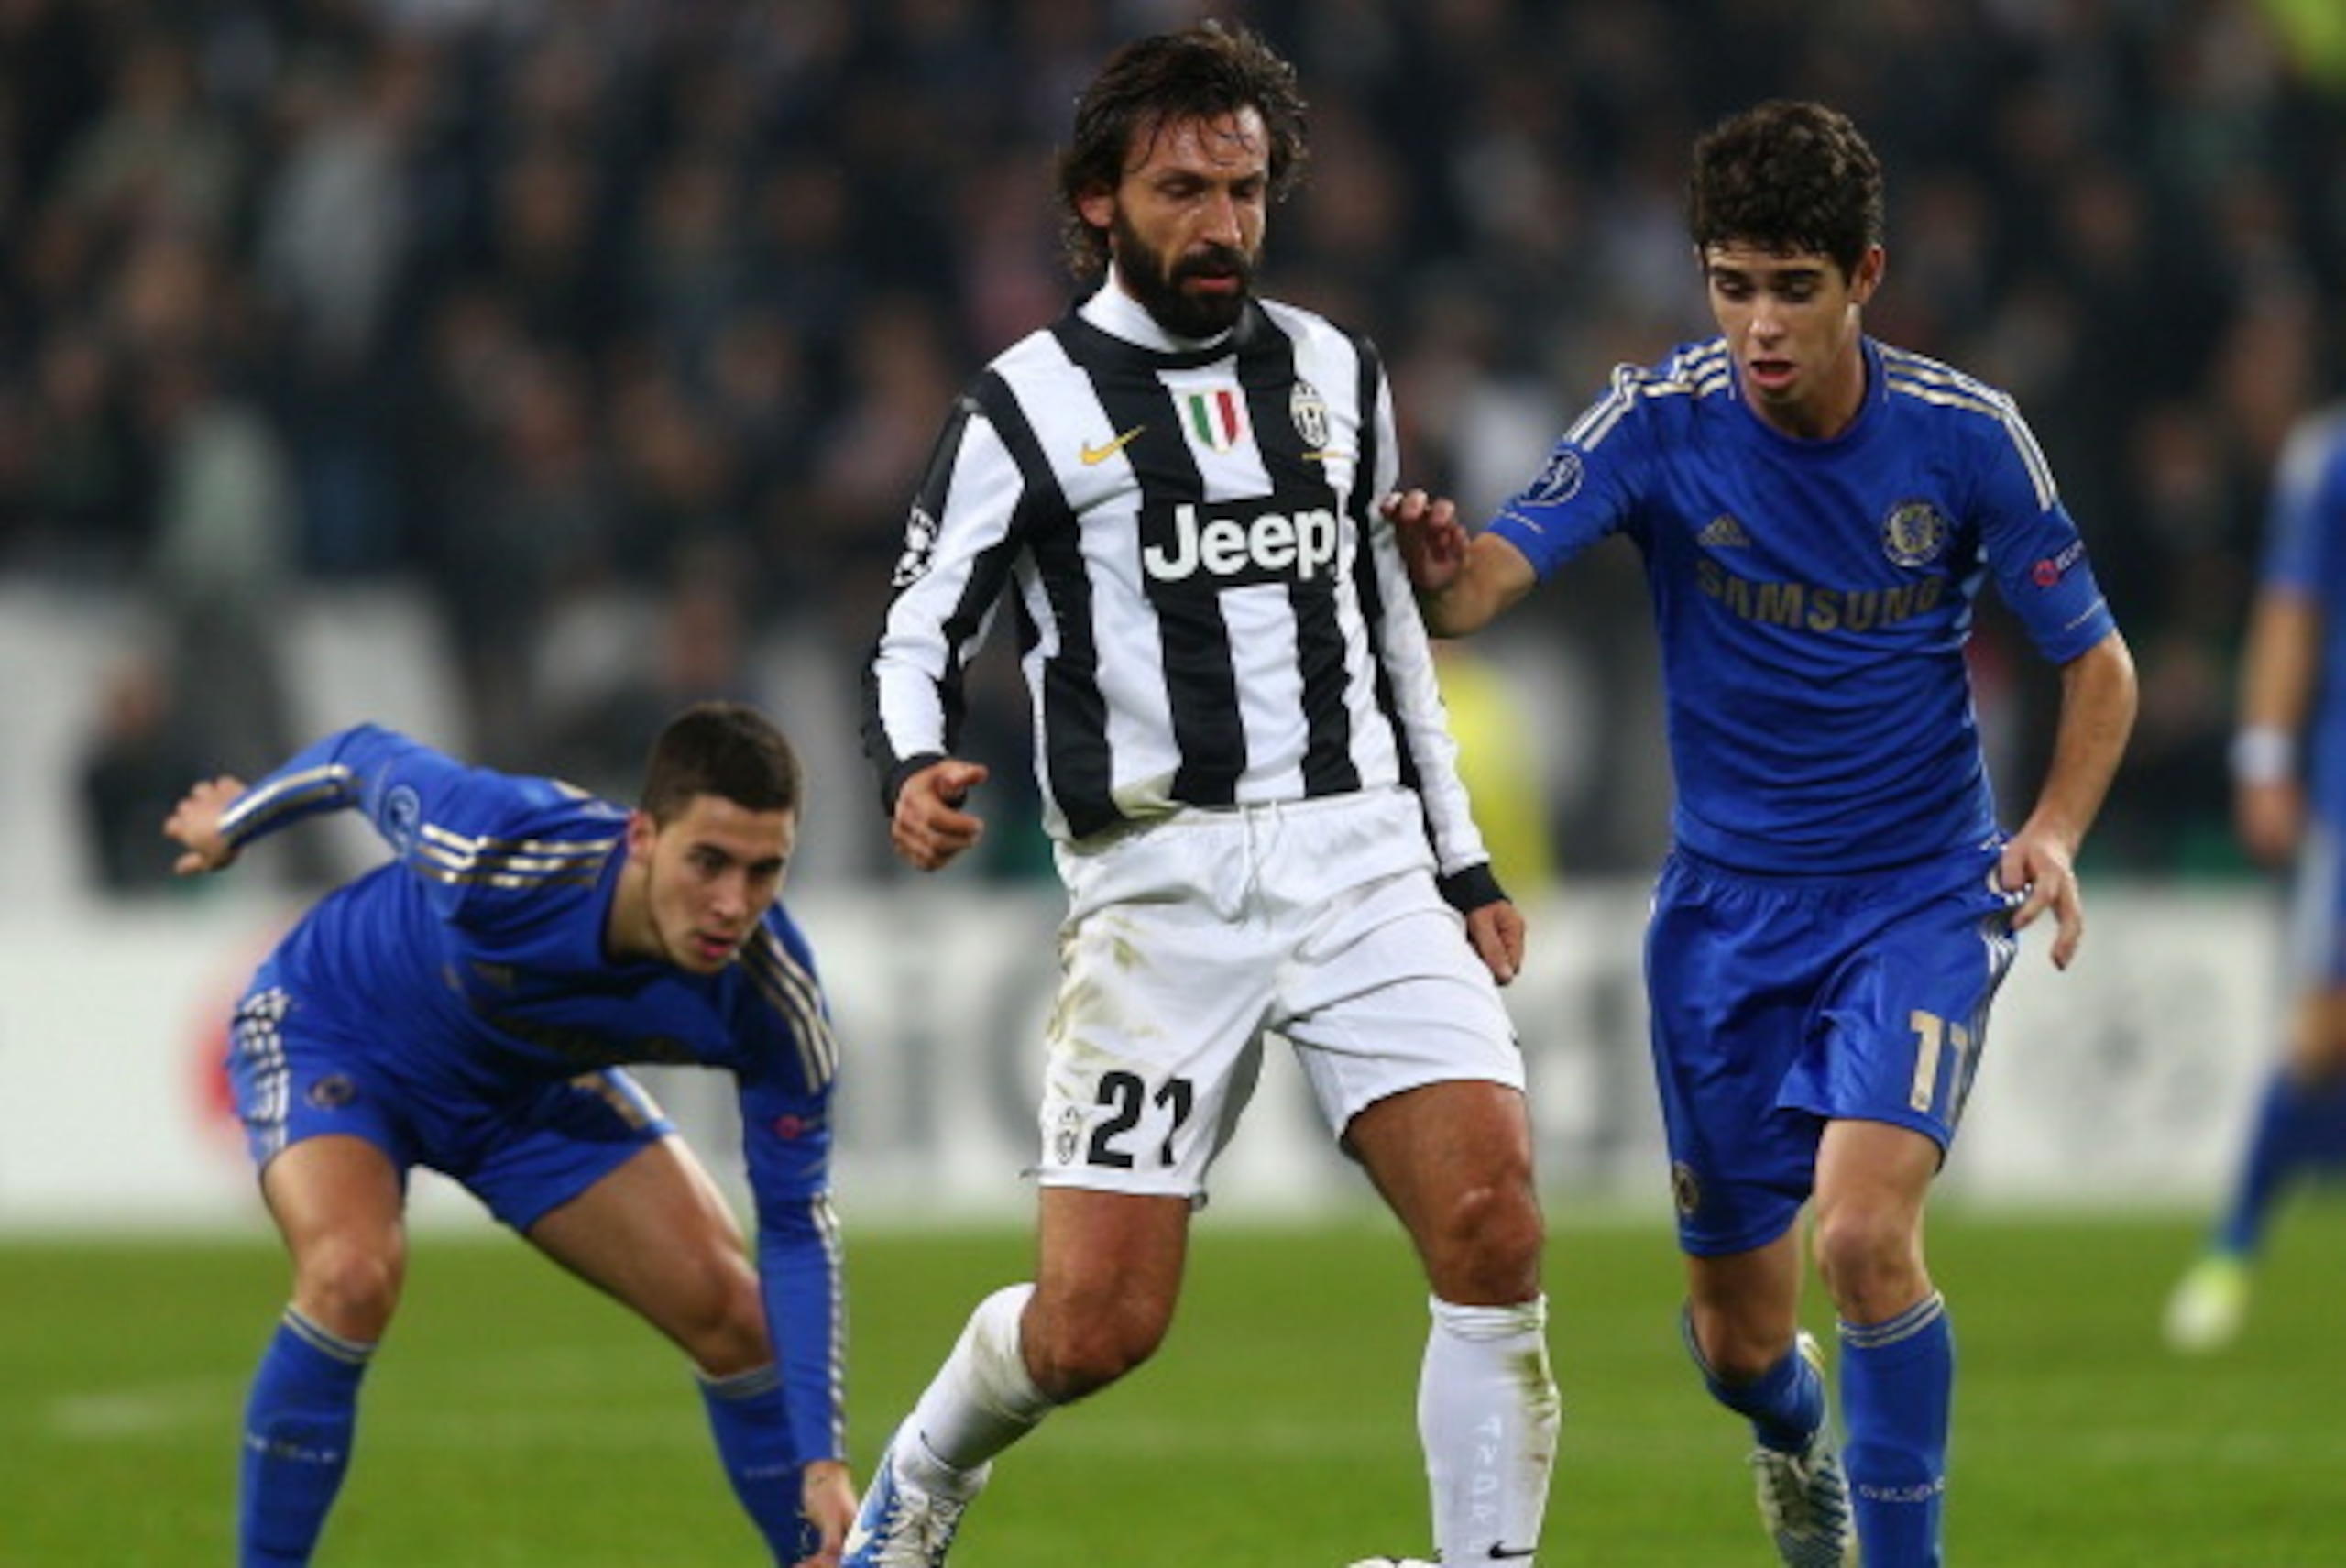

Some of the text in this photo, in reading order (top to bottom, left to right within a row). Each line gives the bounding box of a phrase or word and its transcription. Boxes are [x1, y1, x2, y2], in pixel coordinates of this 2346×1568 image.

[1144, 502, 1338, 582] Jeep
[1697, 558, 1943, 633] SAMSUNG
[1909, 1009, 1969, 1125] 11
[1087, 1070, 1194, 1169] 21
